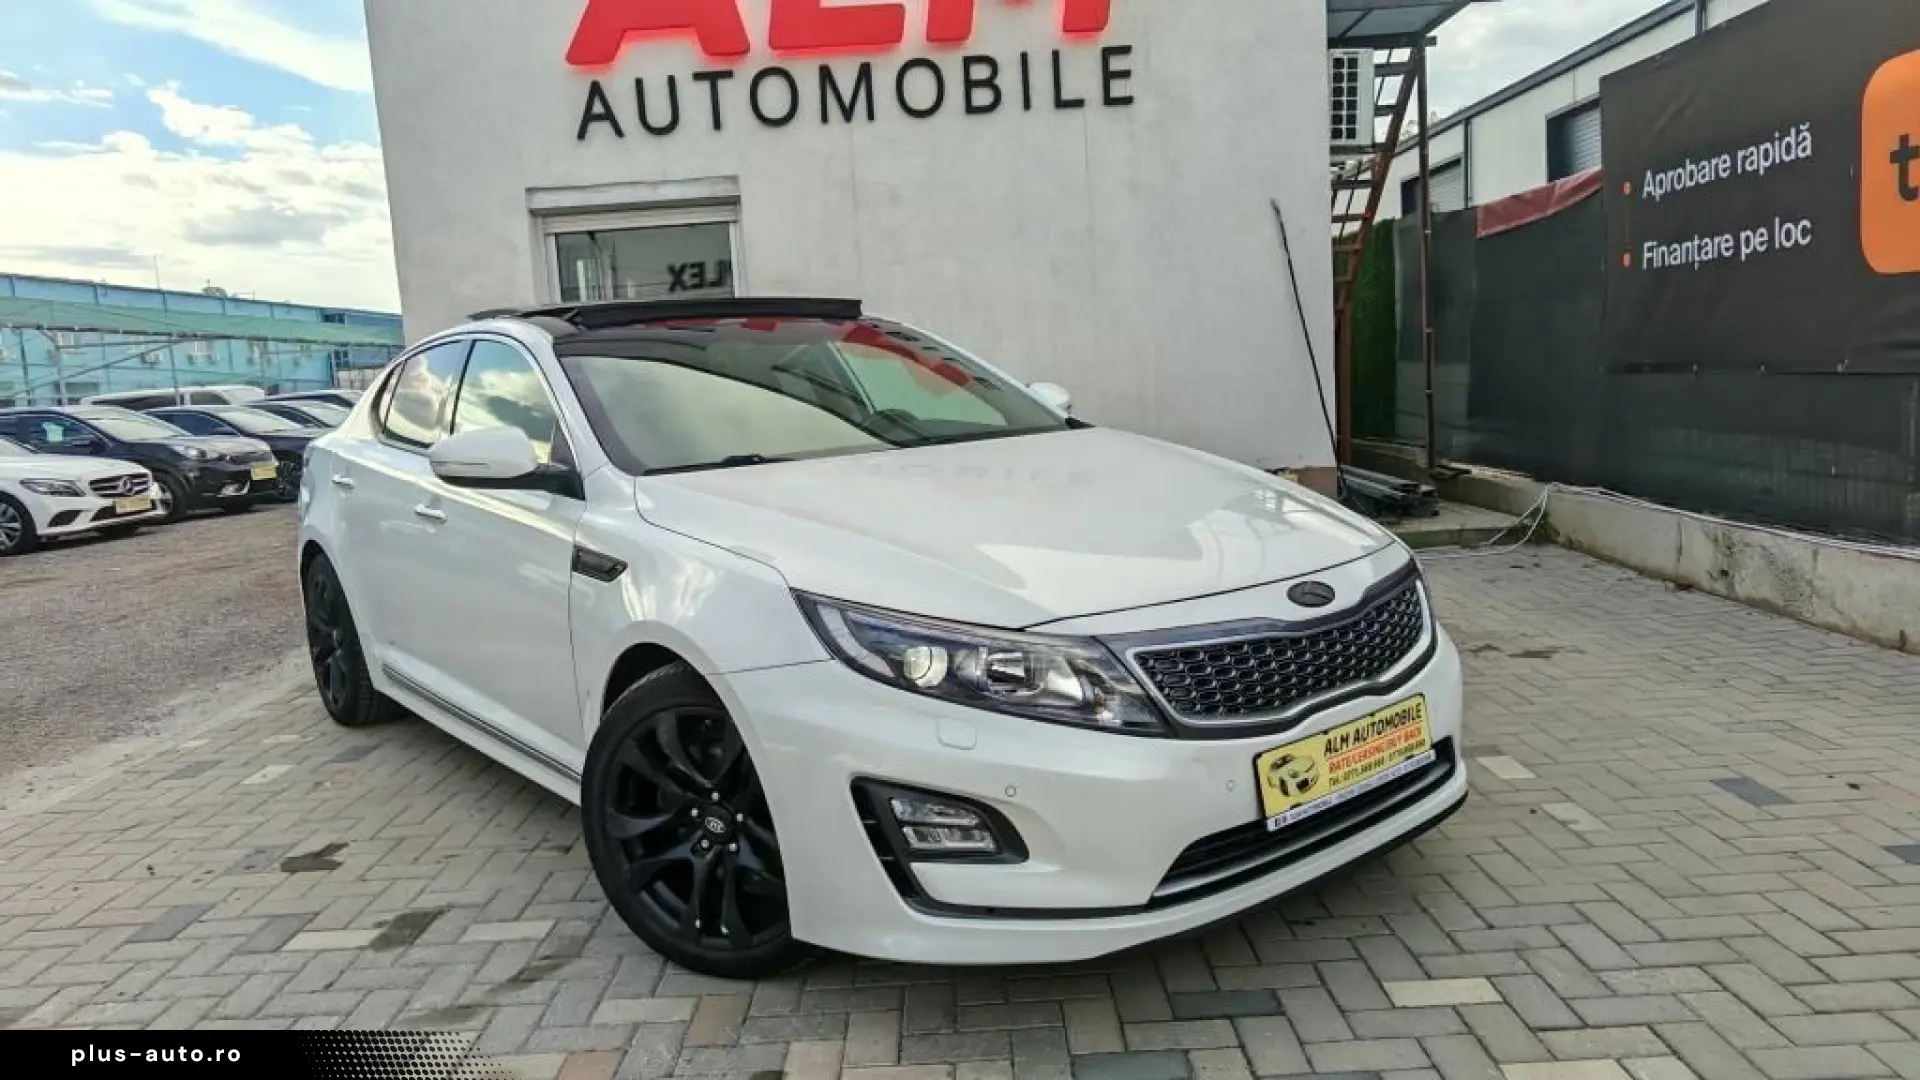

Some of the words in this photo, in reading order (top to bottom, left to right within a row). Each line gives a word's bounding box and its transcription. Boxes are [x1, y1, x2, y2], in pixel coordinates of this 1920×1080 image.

[577, 45, 1134, 140] AUTOMOBILE
[1643, 158, 1731, 202] Aprobare
[1738, 121, 1812, 176] rapidă
[1643, 233, 1734, 271] Finanțare
[1740, 226, 1768, 262] pe
[1775, 215, 1812, 249] loc
[1323, 731, 1350, 758] ALM
[1353, 702, 1423, 746] AUTOMOBILE
